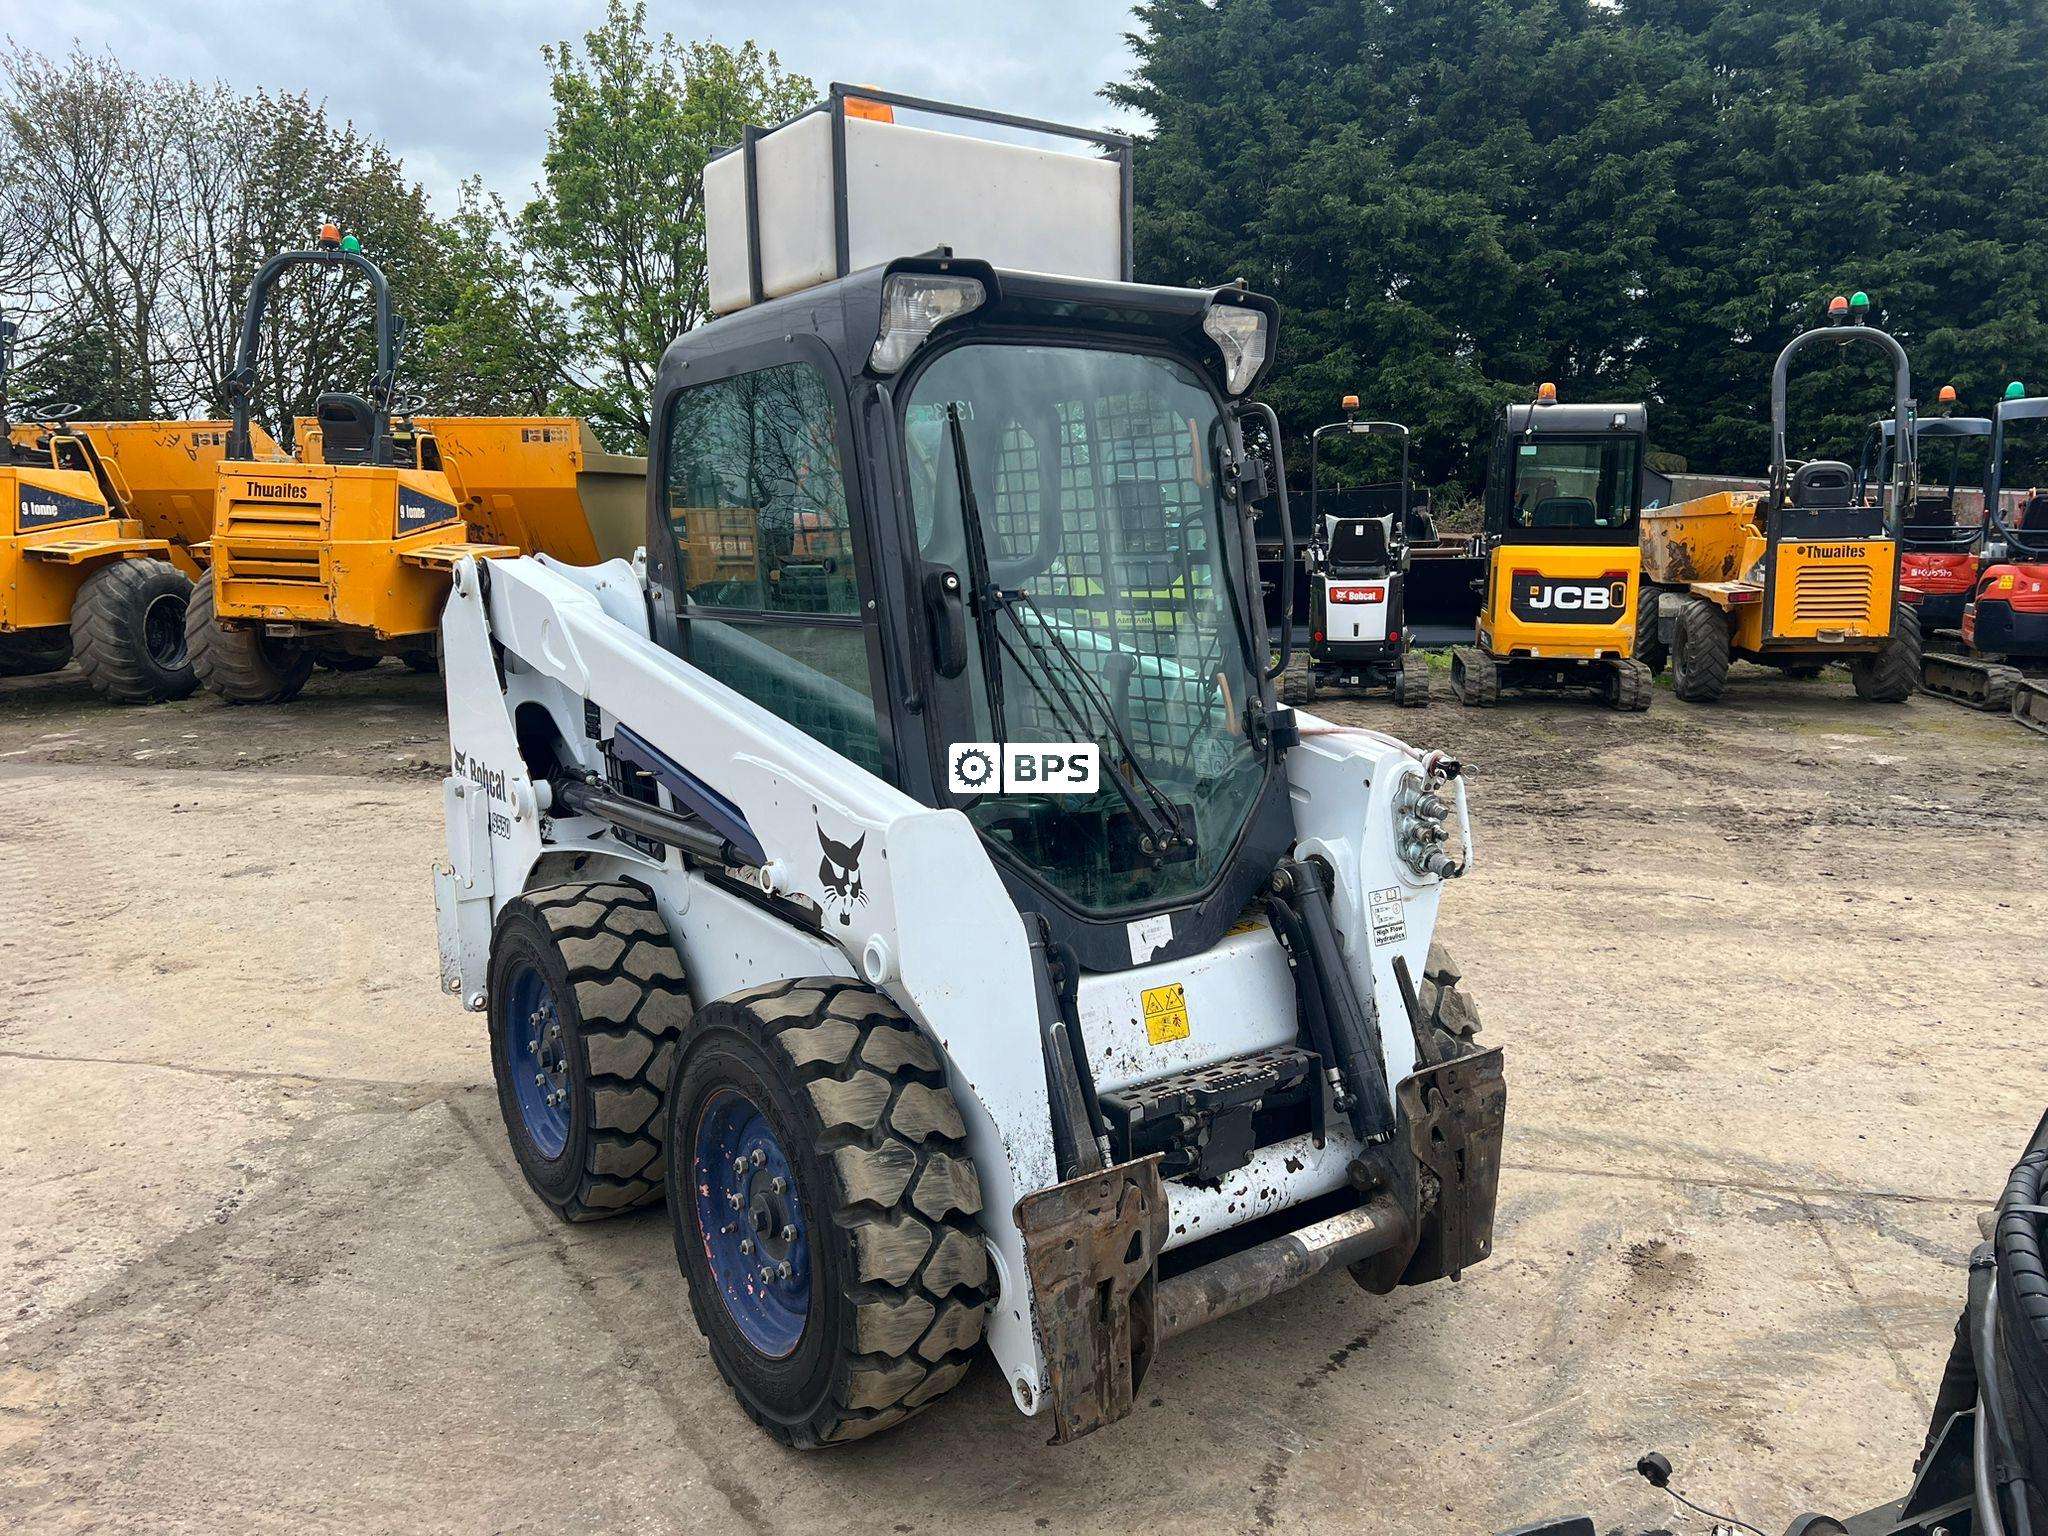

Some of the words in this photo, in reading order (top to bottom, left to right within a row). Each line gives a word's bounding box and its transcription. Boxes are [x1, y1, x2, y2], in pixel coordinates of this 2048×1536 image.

[246, 481, 308, 499] Thwaites
[21, 501, 29, 516] 9
[31, 503, 58, 517] tonne
[406, 505, 425, 518] tonne
[1807, 545, 1866, 559] Thwaites
[1348, 591, 1376, 601] Bobcat
[1529, 585, 1609, 610] JCB
